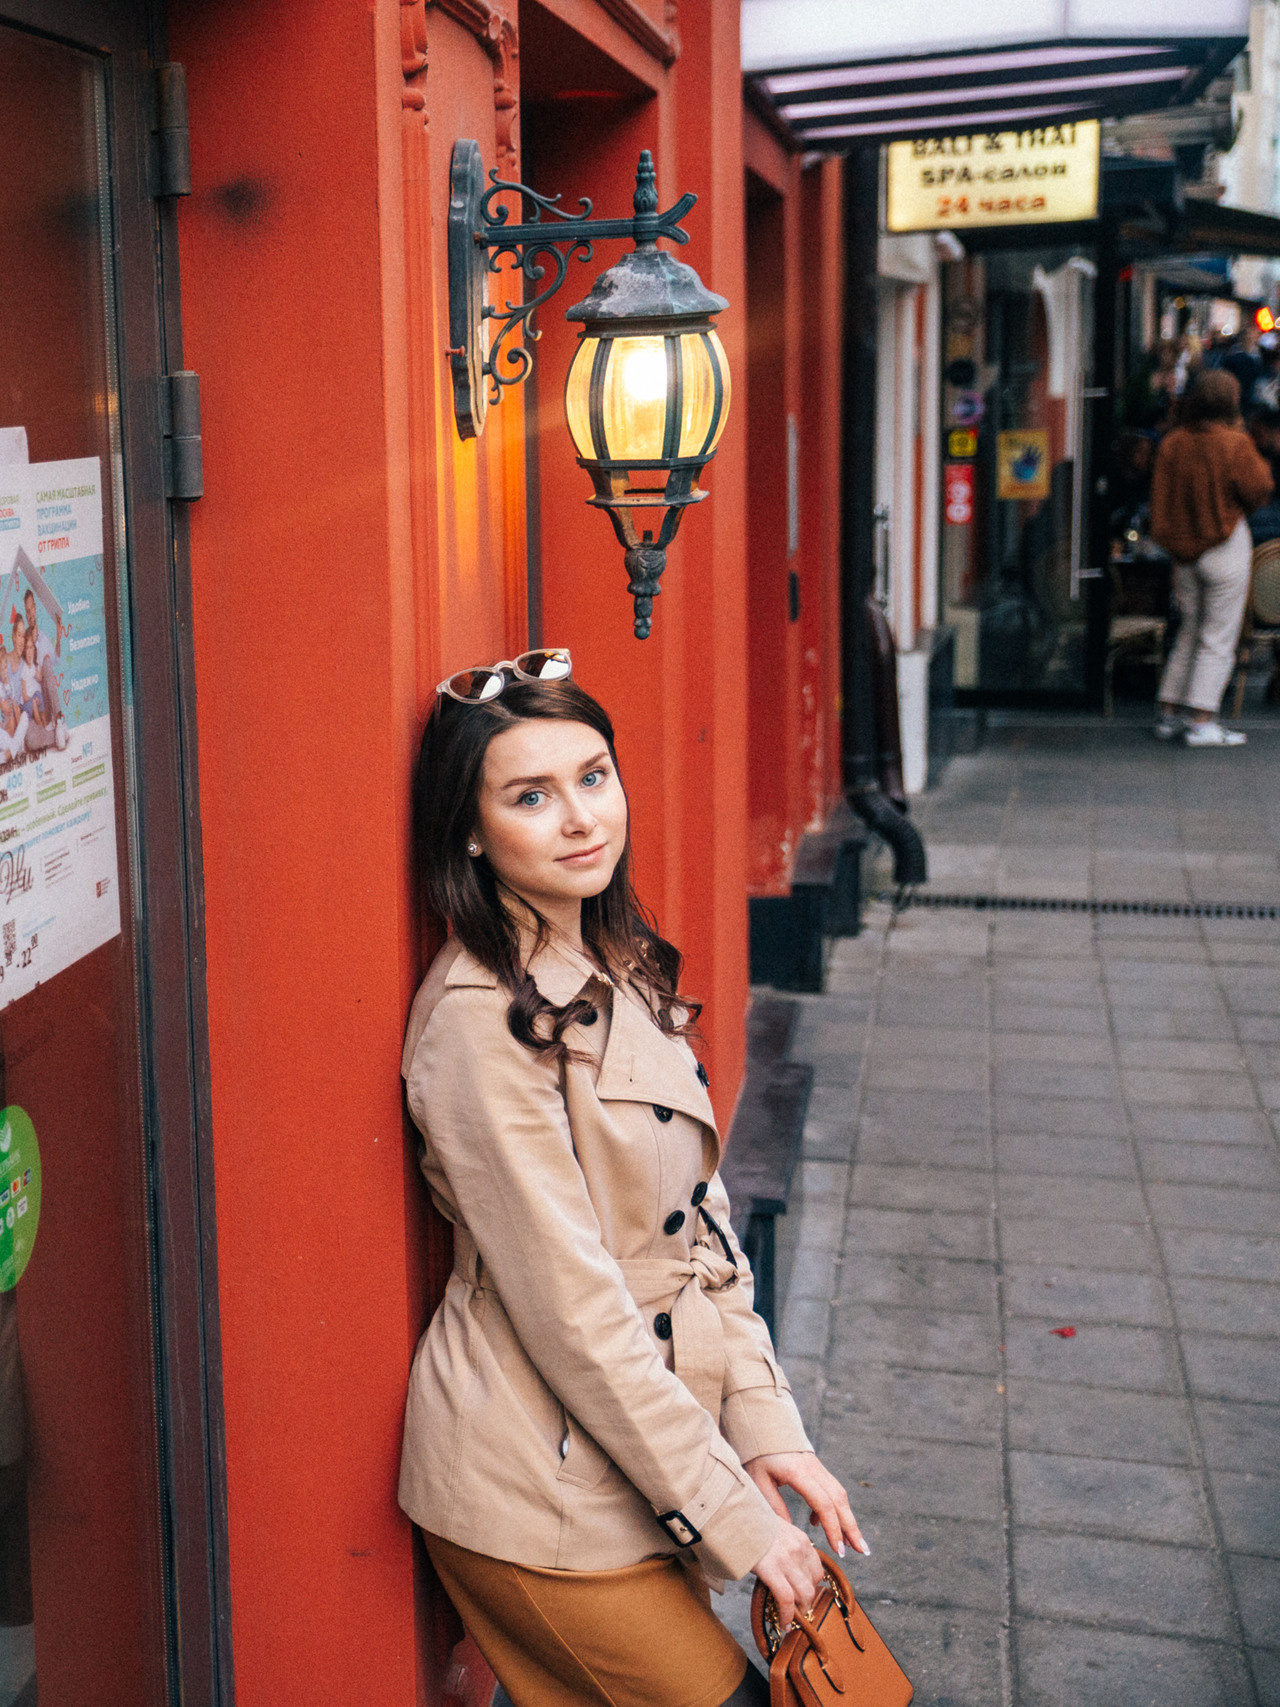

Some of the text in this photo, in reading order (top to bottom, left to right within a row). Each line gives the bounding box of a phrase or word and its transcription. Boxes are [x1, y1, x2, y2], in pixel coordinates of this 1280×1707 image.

[937, 195, 1046, 216] 24 часа
[36, 485, 96, 503] САМАЯ МАСШТАБНАЯ
[36, 504, 72, 520] ПРОГРАММА
[38, 537, 70, 553] ОТ ГРИППА
